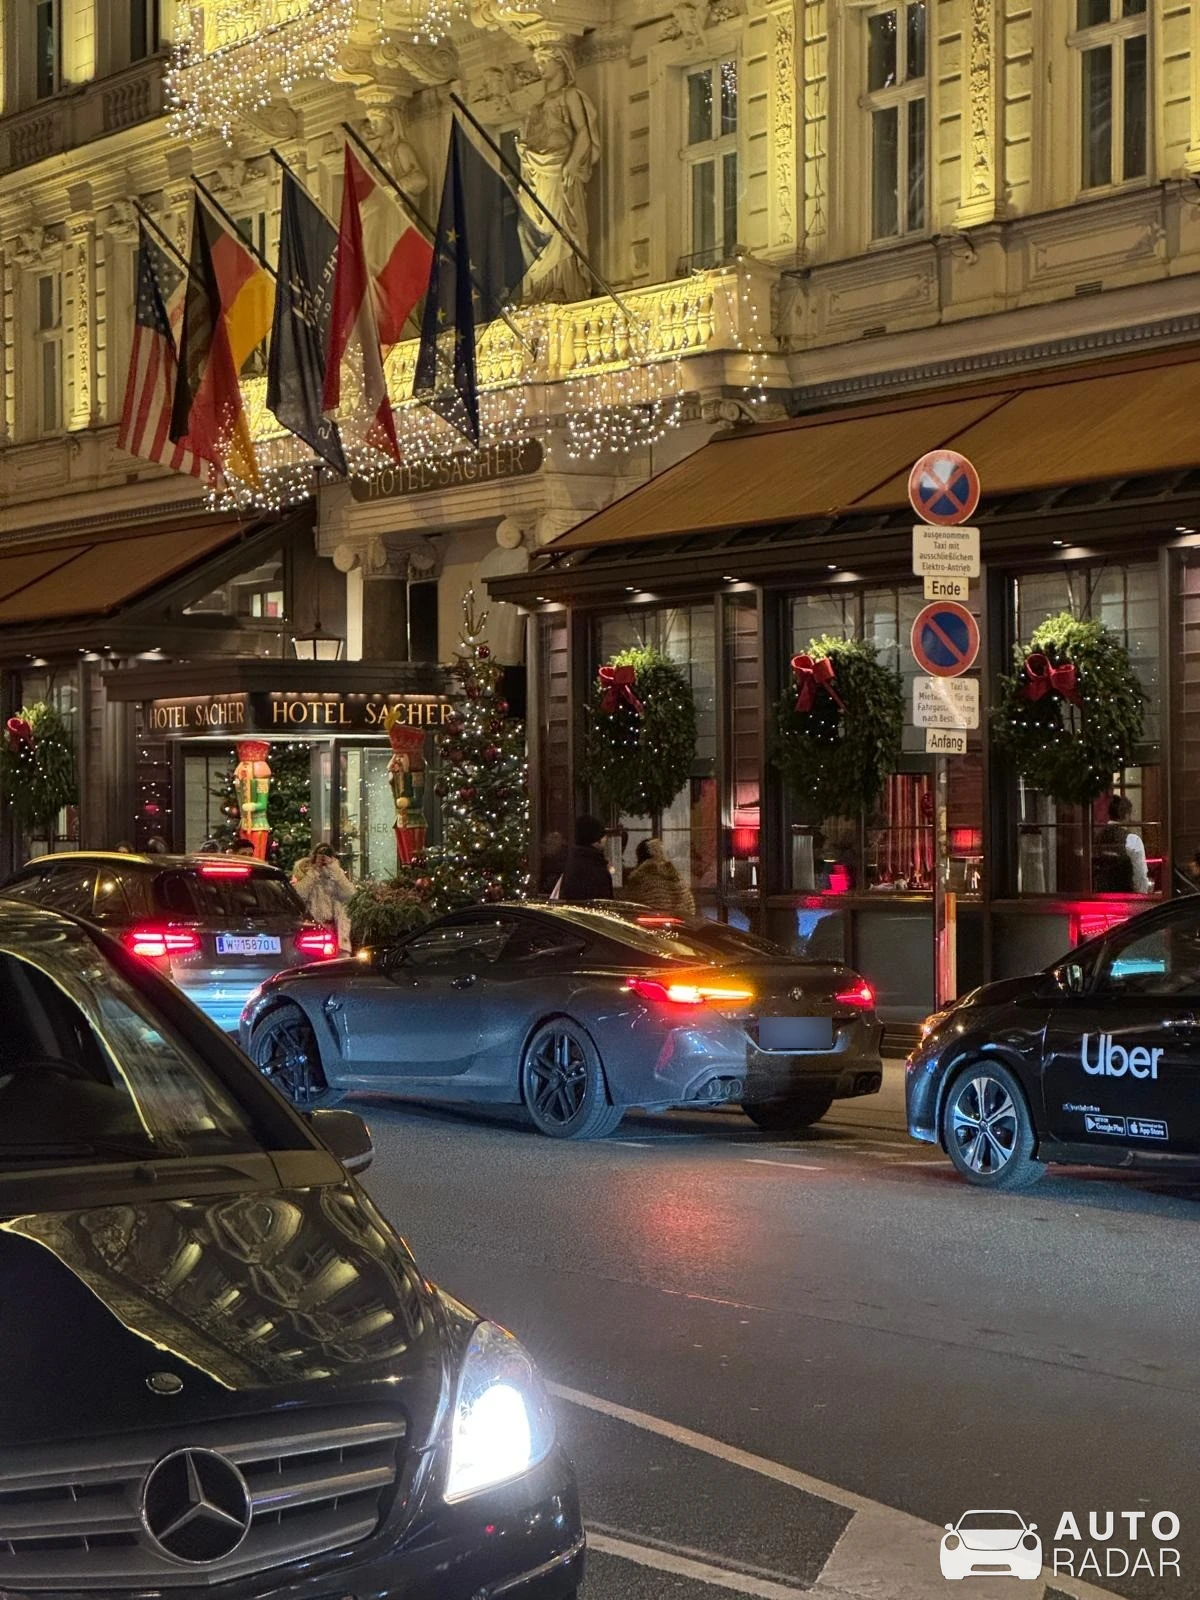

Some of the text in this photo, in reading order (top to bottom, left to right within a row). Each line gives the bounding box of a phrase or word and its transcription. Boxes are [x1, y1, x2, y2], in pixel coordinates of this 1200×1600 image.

[368, 446, 524, 497] HOTEL SACHER
[923, 531, 970, 540] ausgenommen
[933, 541, 960, 550] Taxi mit
[919, 551, 974, 561] ausschließlichem
[922, 562, 972, 572] Elektro-Antrieb
[932, 580, 961, 596] Ende
[149, 702, 245, 729] HOTEL SACHER
[273, 700, 454, 725] HOTEL SACHER
[931, 733, 963, 751] Anfang
[225, 939, 234, 950] W
[1081, 1033, 1164, 1079] Uber
[1095, 1122, 1124, 1134] Google Play
[1140, 1127, 1165, 1136] App Store
